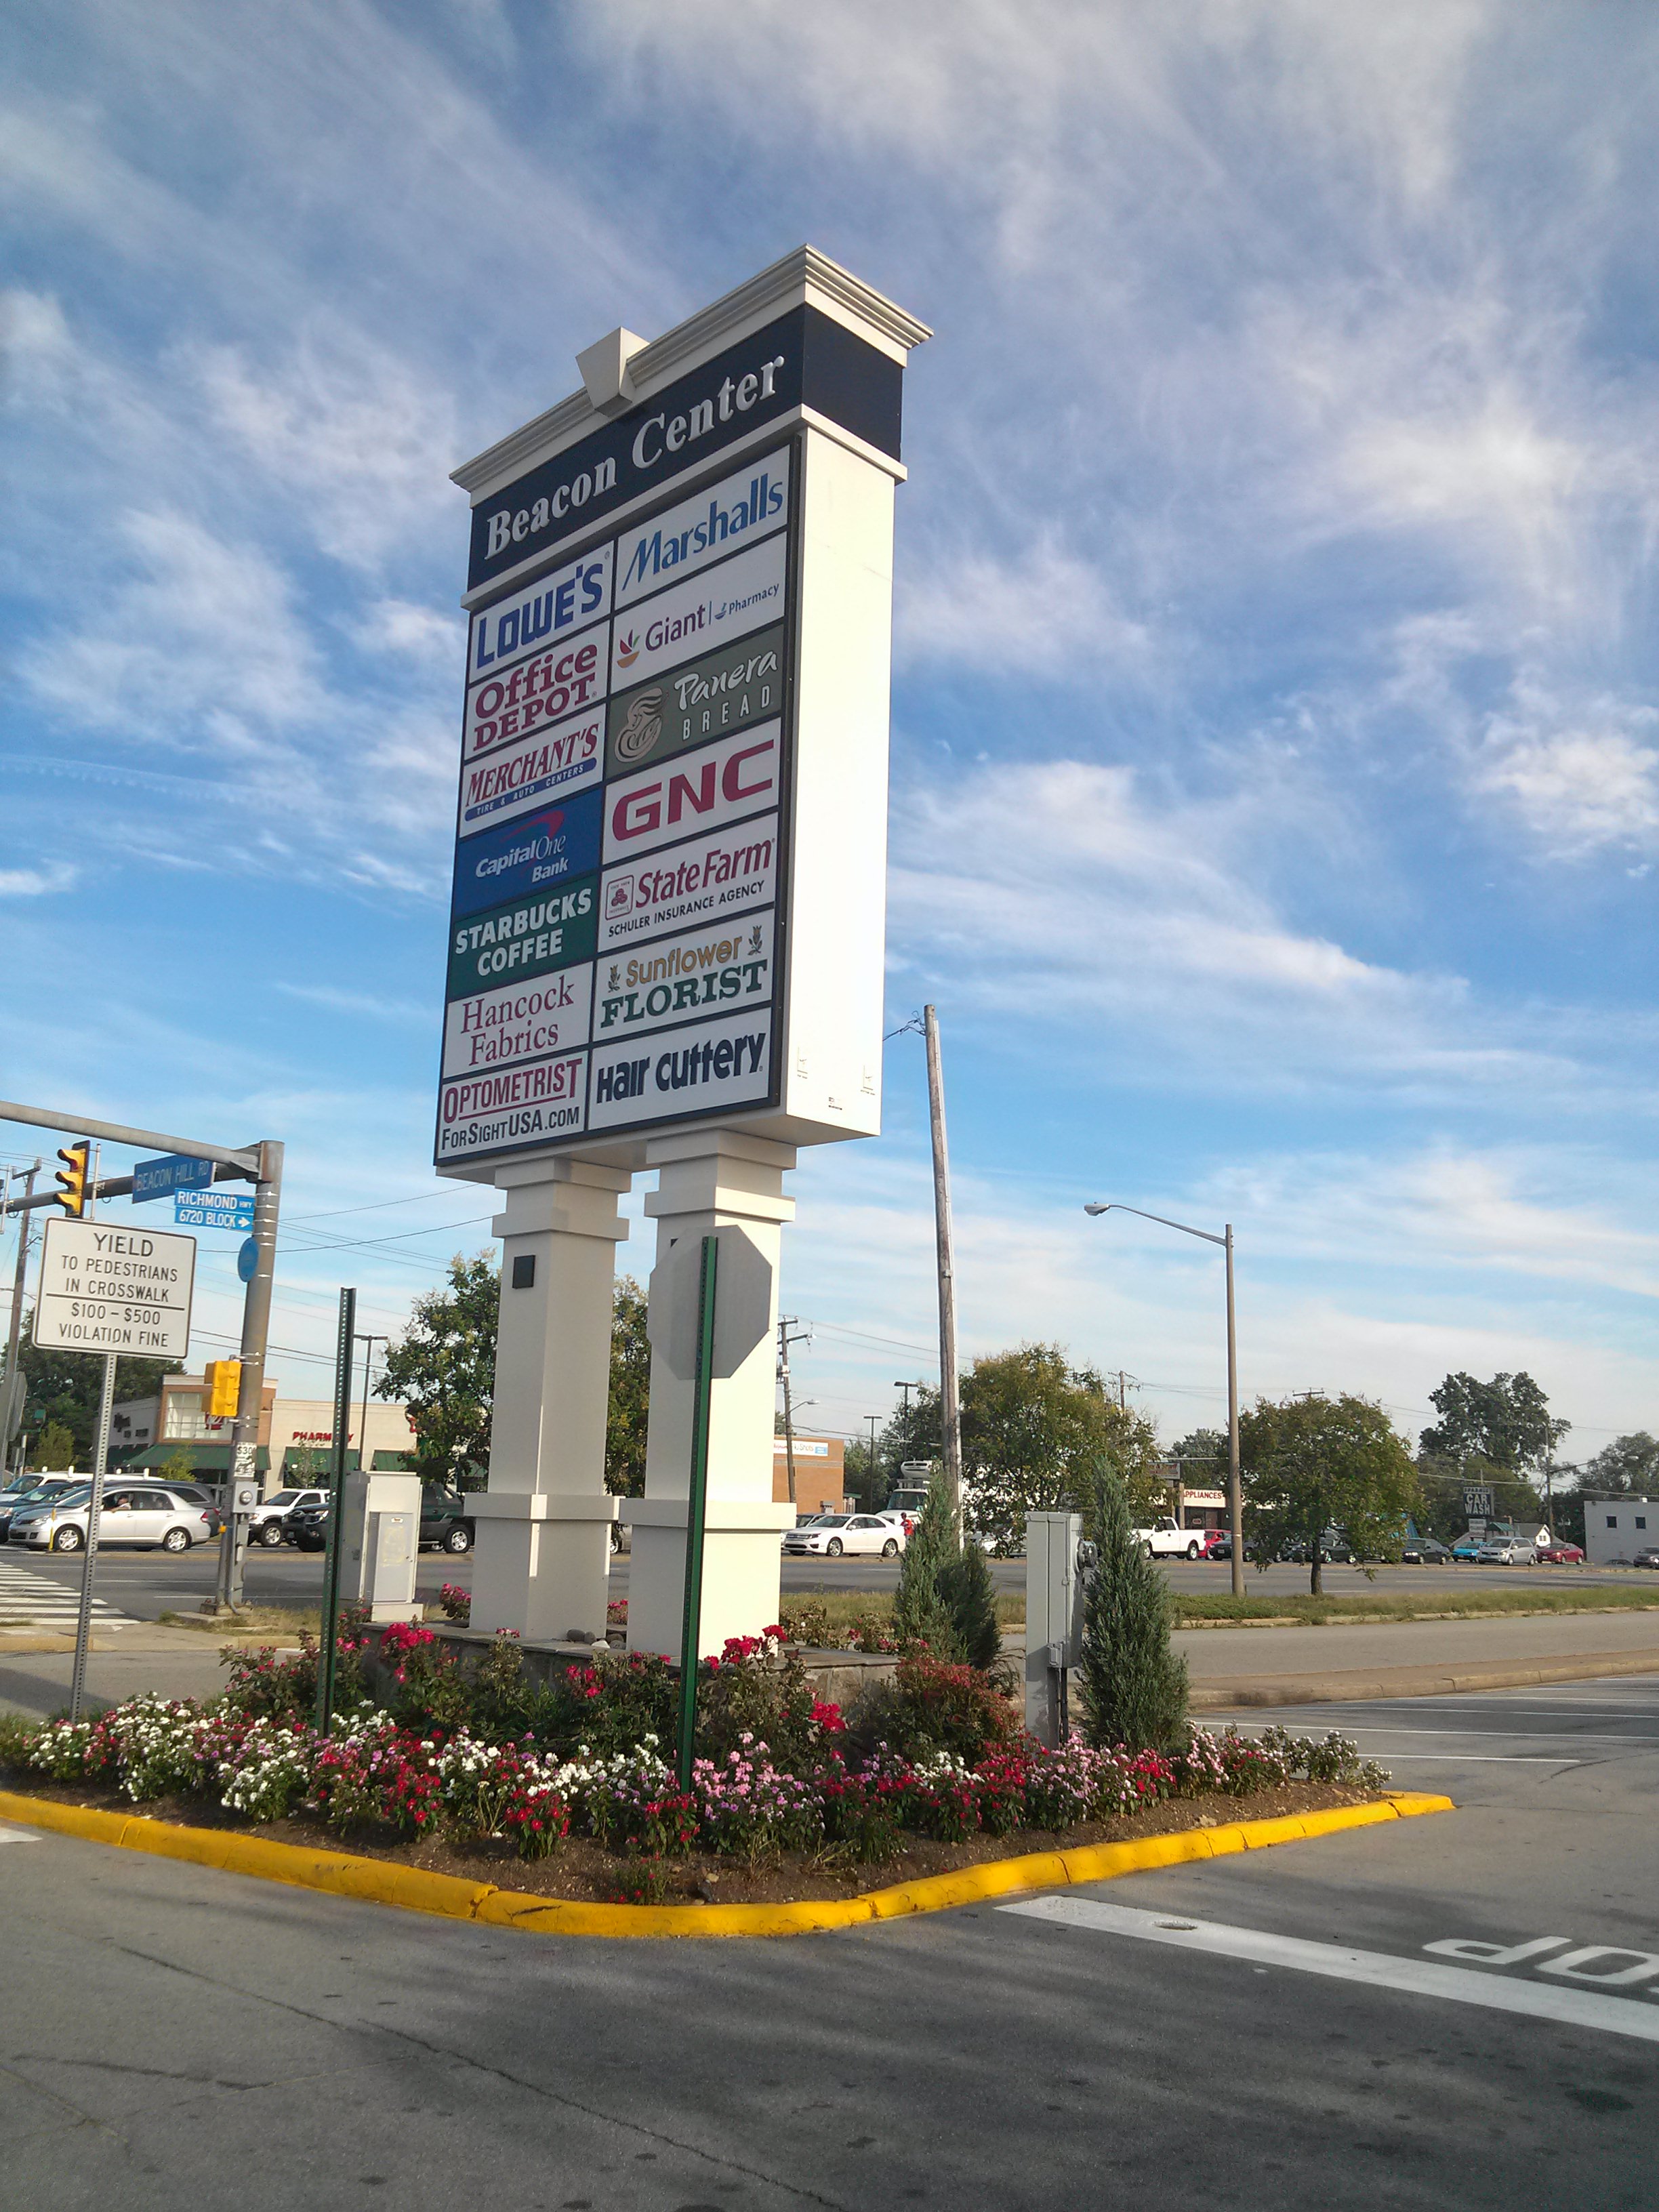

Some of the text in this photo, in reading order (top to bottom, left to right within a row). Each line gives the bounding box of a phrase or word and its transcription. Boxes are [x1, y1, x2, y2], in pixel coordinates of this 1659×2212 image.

[484, 355, 785, 560] Beacon Center
[621, 473, 783, 592] Marshalls
[477, 563, 604, 670] LOWE'S
[645, 583, 779, 651] Giant Pharmacy
[476, 644, 598, 719] Office
[674, 651, 778, 711] Panera
[474, 672, 596, 752] DEPOT
[682, 685, 770, 741] BREAD
[466, 723, 599, 807] MERCHANT'S
[476, 764, 584, 815] TIRE & AUTO CENTERS
[612, 739, 775, 841] GNC
[531, 857, 569, 883] Bank
[455, 888, 592, 954] STARBUCKS
[609, 880, 765, 937] SCHULER INSURANCE AGENCY
[477, 928, 563, 977] COFFEE
[626, 936, 743, 987] Sunflower
[460, 975, 575, 1034] Hancock
[600, 959, 768, 1029] FLORIST
[469, 1019, 559, 1067] Fabrics
[444, 1058, 583, 1124] OPTOMETRIST
[596, 1056, 651, 1104] Hair
[136, 1160, 210, 1192] BEACON HILL RD
[178, 1191, 253, 1210] RICHMOND HWY
[180, 1210, 236, 1227] 6720 BLOCK
[62, 1255, 178, 1282] TO PEDESTRIANS
[94, 1233, 154, 1257] YIELD
[66, 1277, 169, 1303] IN CROSSWALK
[71, 1302, 106, 1319] $100
[124, 1307, 161, 1325] $500
[59, 1323, 169, 1347] VIOLATION FINE
[293, 1431, 354, 1443] PHARMY
[1465, 1503, 1490, 1515] WASH
[1466, 1494, 1488, 1504] CAR
[1422, 1935, 1659, 1992] OP
